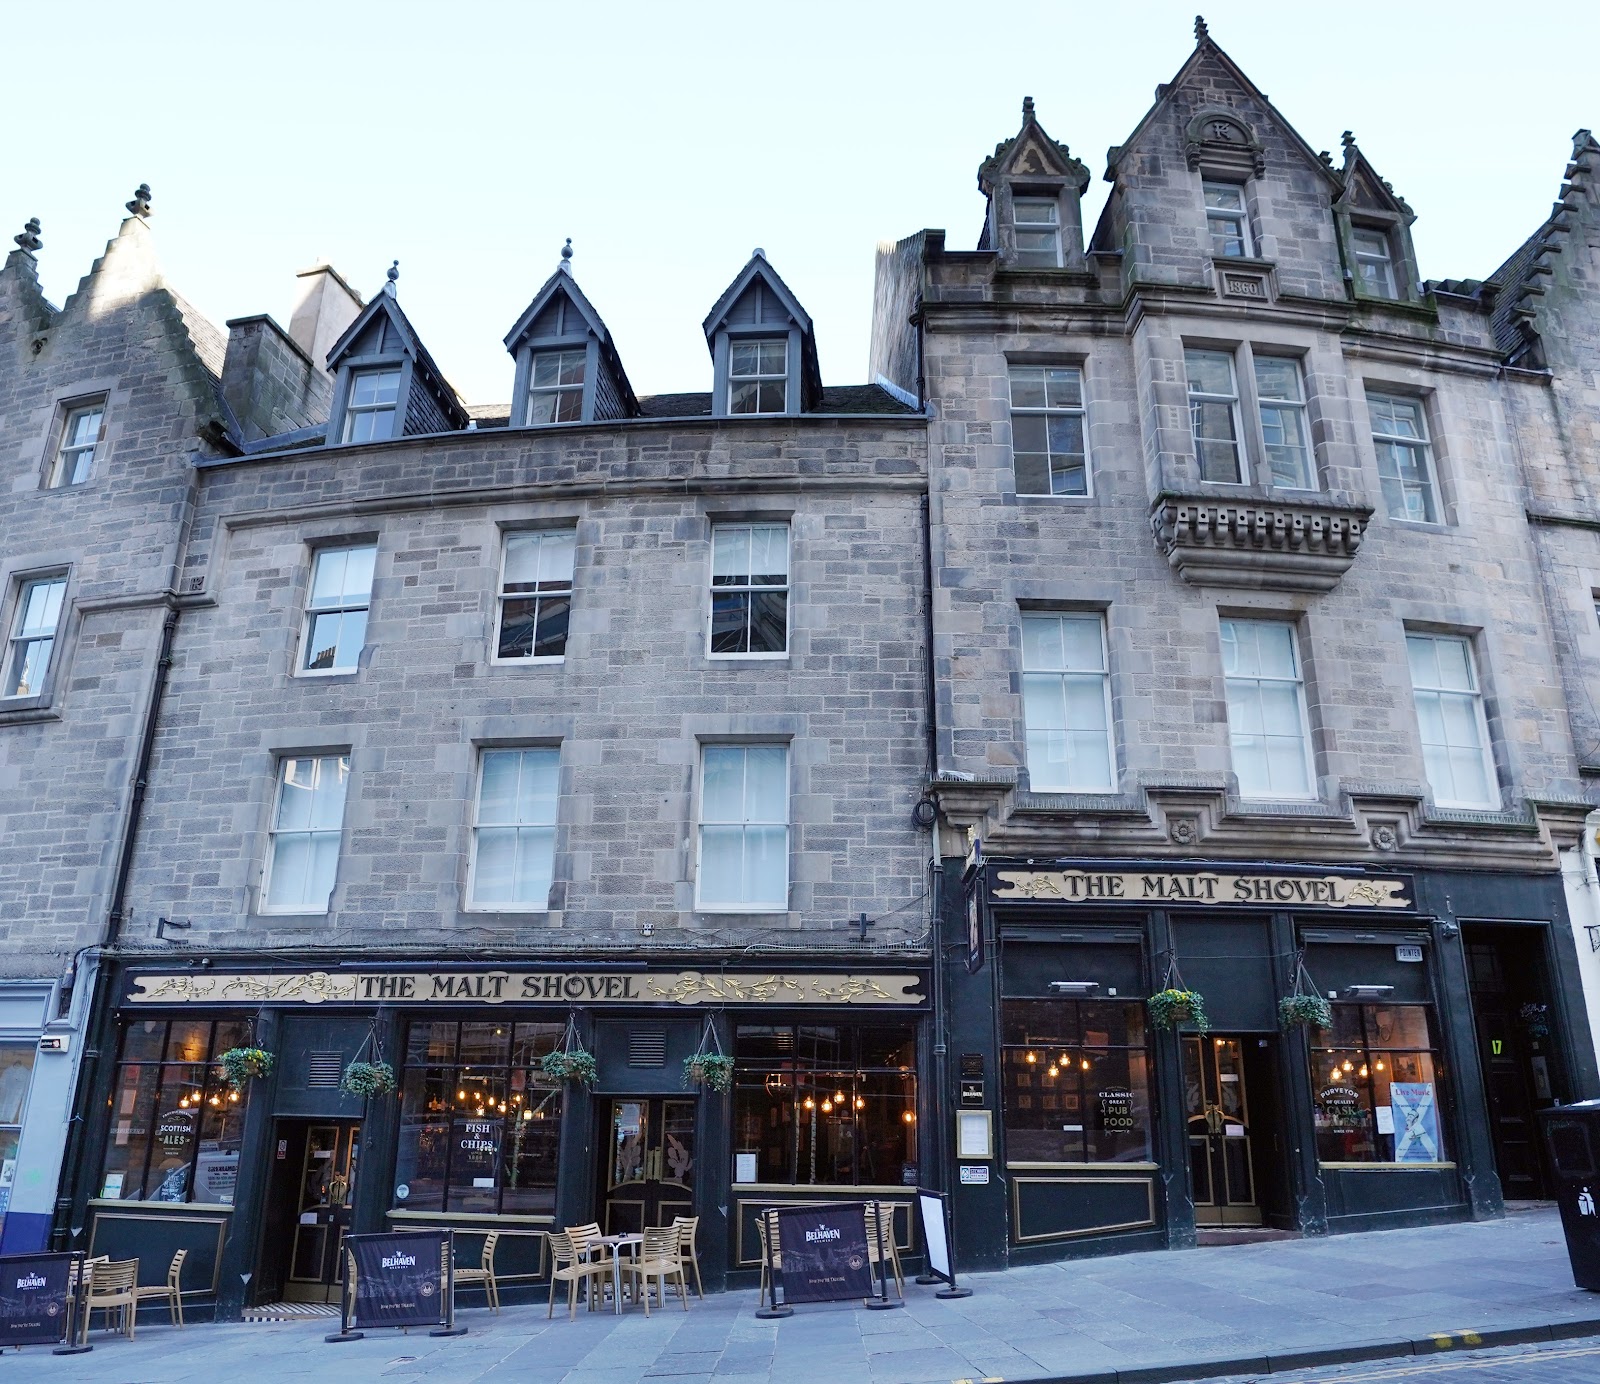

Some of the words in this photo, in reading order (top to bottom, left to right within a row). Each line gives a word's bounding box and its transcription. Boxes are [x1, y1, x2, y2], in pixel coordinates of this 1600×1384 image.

[1229, 280, 1258, 294] 1860
[1064, 875, 1125, 898] THE
[1141, 875, 1219, 900] MALT
[1233, 878, 1346, 903] SHOVEL
[360, 975, 416, 998] THE
[430, 975, 510, 998] MALT
[521, 975, 640, 998] SHOVEL
[1492, 1040, 1502, 1055] 17
[1320, 1087, 1359, 1099] PURVEYOR
[1108, 1106, 1129, 1115] PUB
[1326, 1106, 1356, 1116] CASK
[1103, 1117, 1134, 1126] FOOD
[160, 1125, 191, 1133] SCOTTISH
[465, 1123, 491, 1133] FISH
[163, 1135, 186, 1145] ALES
[474, 1132, 480, 1140] &
[460, 1140, 494, 1149] CHIPS
[804, 1229, 841, 1242] BELHAVEN
[382, 1255, 416, 1268] BELHAVEN
[16, 1276, 47, 1289] BELHAVEN
